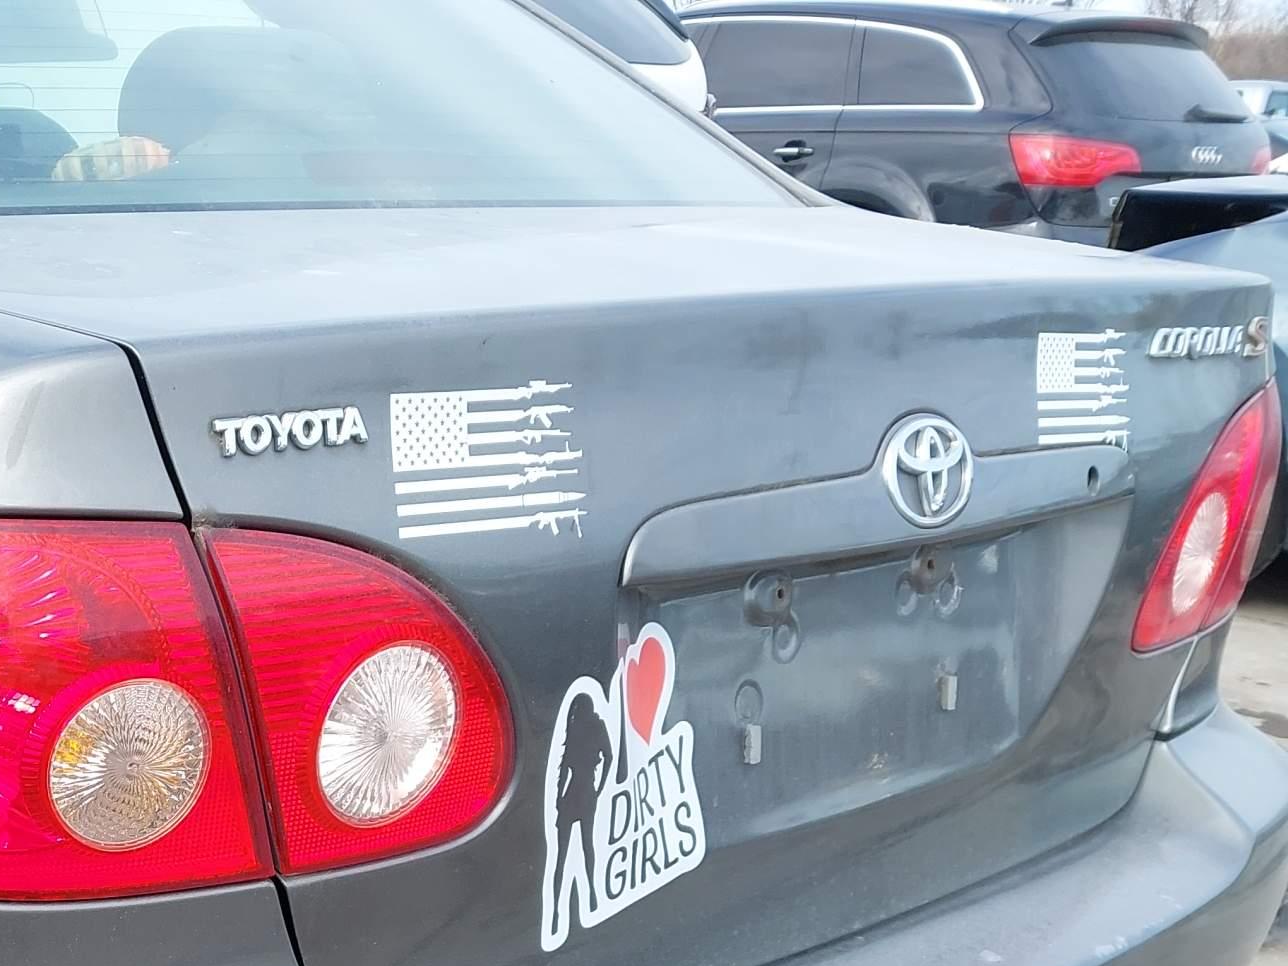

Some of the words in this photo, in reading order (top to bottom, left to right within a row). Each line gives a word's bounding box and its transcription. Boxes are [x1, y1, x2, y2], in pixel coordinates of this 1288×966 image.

[212, 406, 369, 458] TOYOTA
[608, 735, 685, 846] DIRTY
[605, 801, 697, 900] GIRLS
